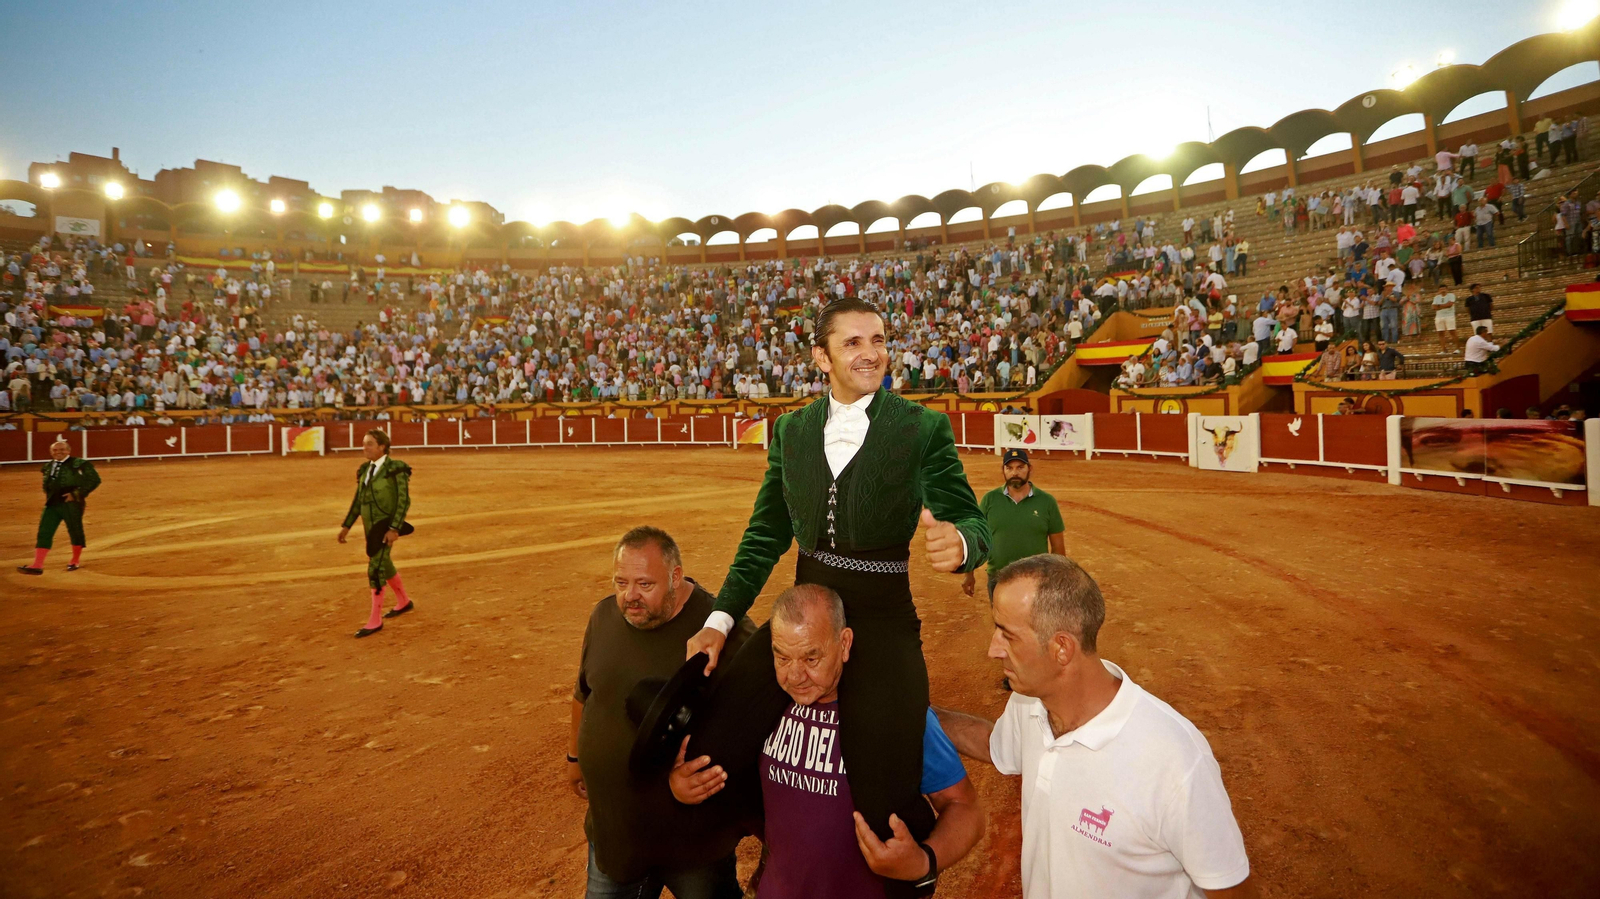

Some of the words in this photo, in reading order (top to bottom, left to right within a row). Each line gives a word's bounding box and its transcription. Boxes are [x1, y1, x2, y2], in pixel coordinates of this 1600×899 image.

[790, 702, 839, 724] HOTEL
[762, 715, 805, 767] LACIO
[804, 726, 836, 773] DEL
[768, 763, 838, 797] SANTANDER
[1071, 824, 1112, 847] ALMENDRAS
